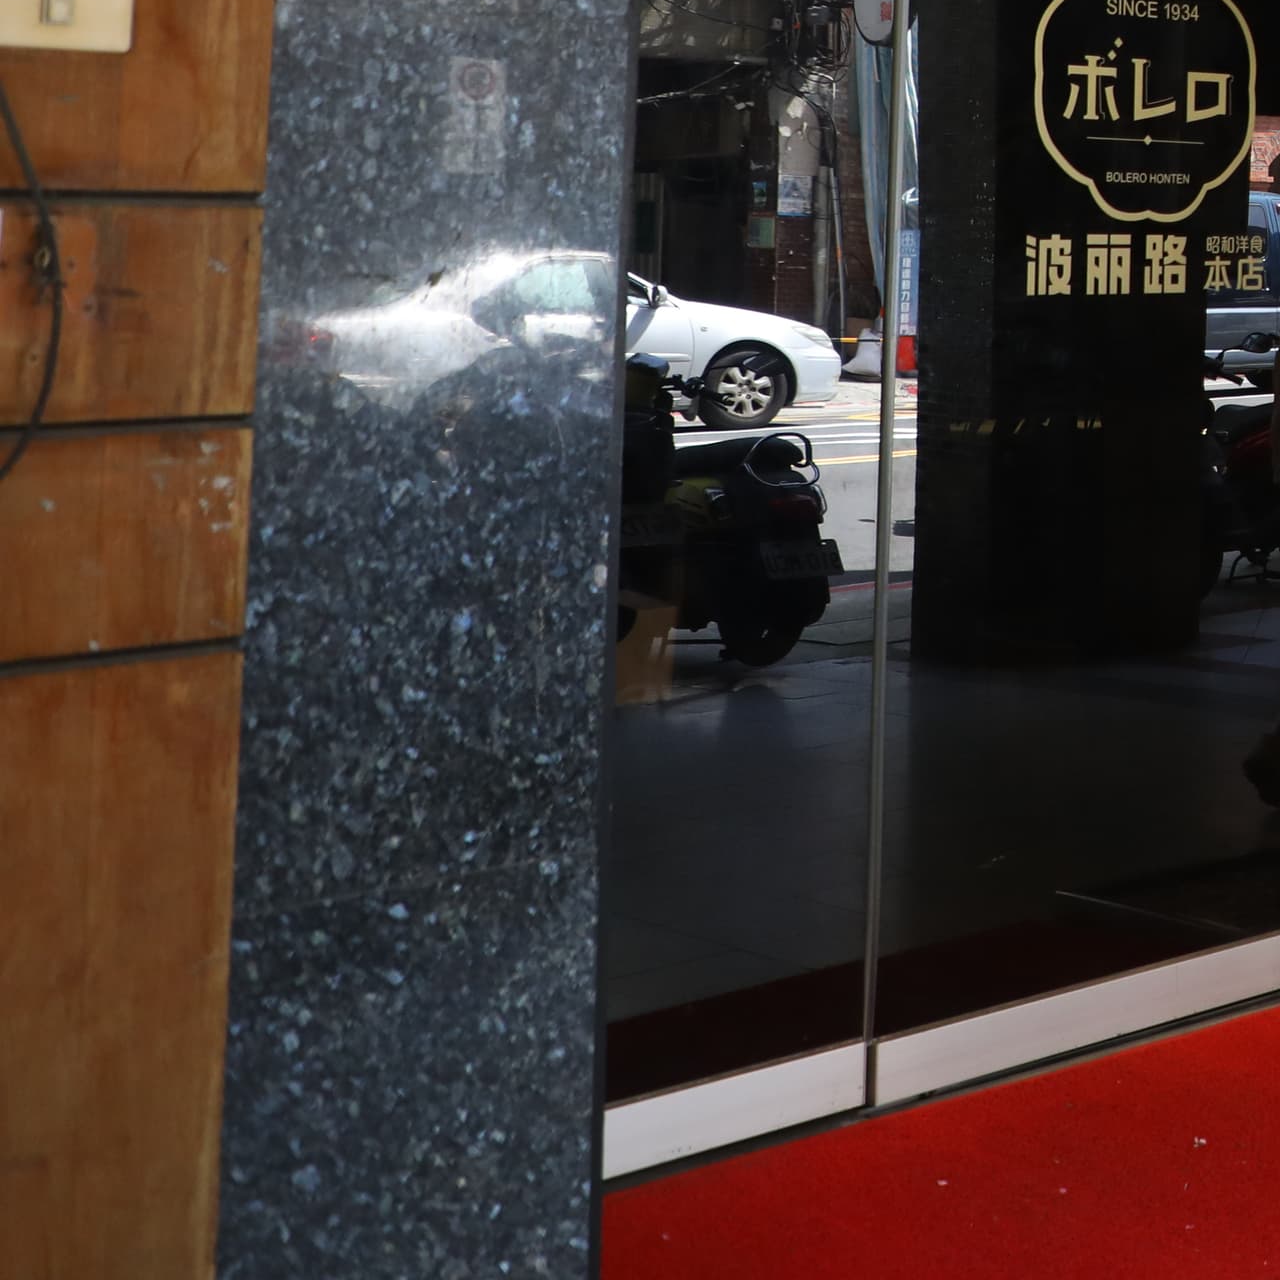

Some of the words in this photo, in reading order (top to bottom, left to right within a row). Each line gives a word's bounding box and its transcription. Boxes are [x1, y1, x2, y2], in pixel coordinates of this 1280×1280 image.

[1163, 2, 1200, 21] 1934
[1062, 36, 1234, 123] ボレロ
[1106, 171, 1148, 184] BOLERO
[1149, 172, 1190, 185] HONTEN
[1206, 235, 1265, 255] 昭和洋食
[1026, 234, 1188, 297] 波丽路
[1203, 256, 1266, 292] 本店
